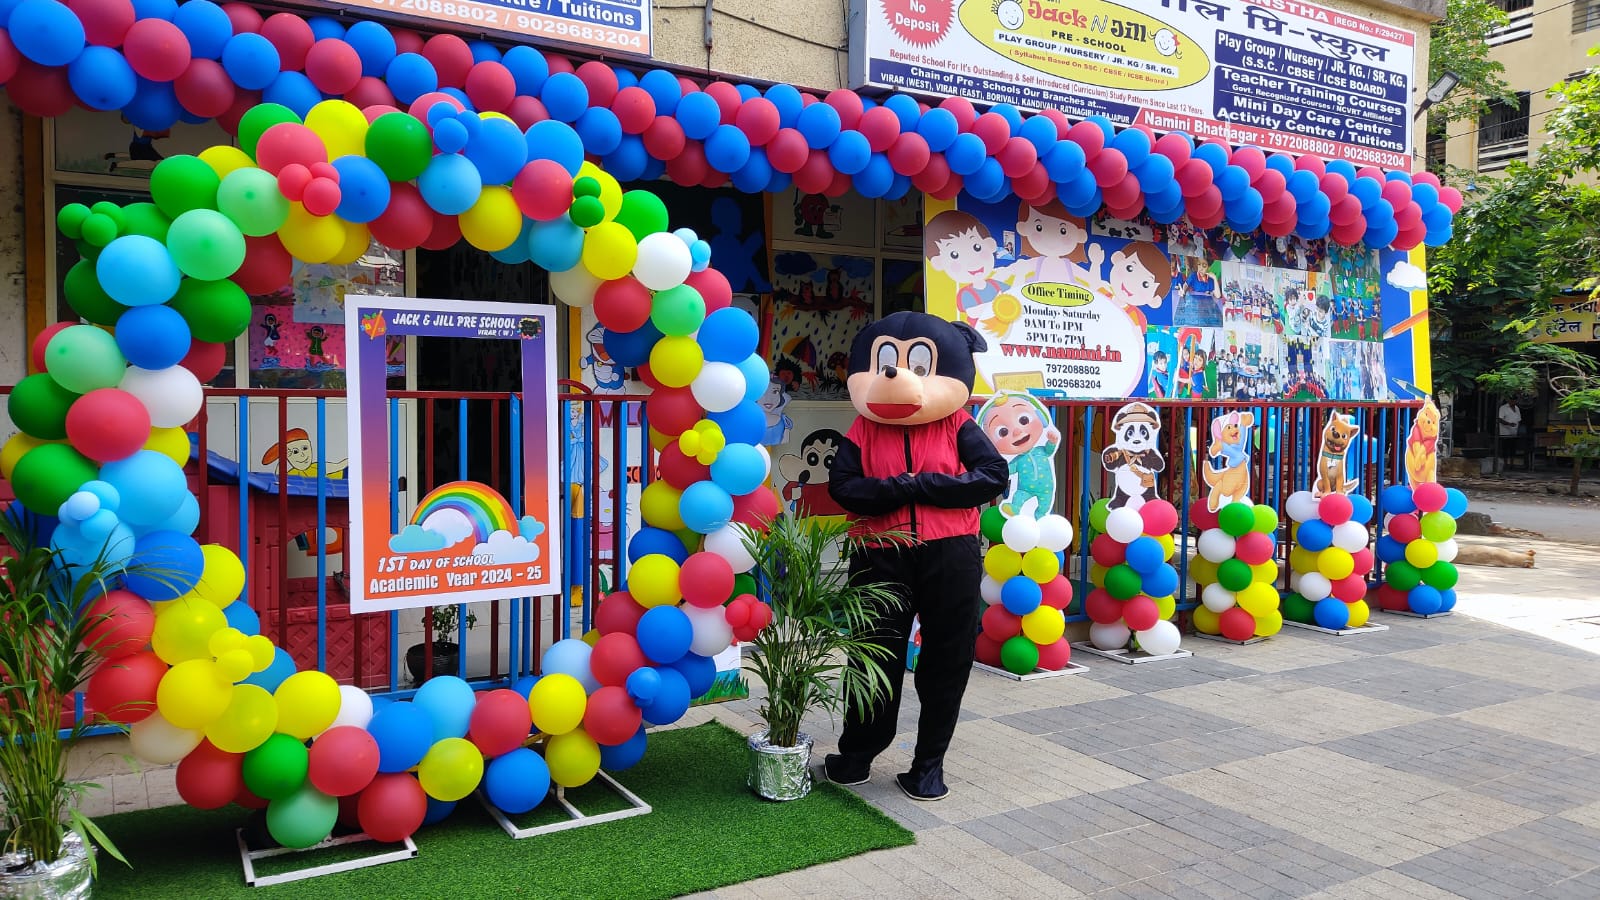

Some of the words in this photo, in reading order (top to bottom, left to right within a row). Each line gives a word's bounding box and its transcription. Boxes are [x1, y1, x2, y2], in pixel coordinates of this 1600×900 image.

[558, 0, 635, 26] Tuitions
[910, 0, 926, 14] No
[1028, 0, 1088, 29] Jack
[1090, 14, 1109, 34] N
[1110, 19, 1147, 42] Jill
[516, 15, 641, 48] 9029683204
[895, 12, 940, 34] Deposit
[998, 33, 1022, 45] PLAY
[1025, 38, 1057, 51] GROUP
[1064, 47, 1106, 62] NURSERY
[1112, 57, 1125, 66] JR.
[1127, 60, 1139, 69] KG
[1145, 63, 1159, 72] SR.
[1161, 66, 1175, 76] KG.
[1051, 30, 1073, 42] PRE
[1083, 37, 1127, 53] SCHOOL
[1015, 50, 1045, 61] Syllabus
[1048, 56, 1070, 67] Based
[1072, 60, 1082, 68] On
[1084, 63, 1098, 72] SSC
[1104, 66, 1122, 77] CBSE
[1128, 72, 1143, 82] ICSE
[1218, 31, 1242, 52] Play
[1244, 38, 1275, 60] Group
[1284, 47, 1323, 72] Nursery
[1331, 60, 1346, 75] JR.
[1348, 63, 1366, 79] KG.
[1372, 69, 1388, 84] SR.
[1390, 74, 1406, 89] KG.
[881, 72, 905, 86] VIRAR
[906, 77, 934, 93] (WEST),
[936, 83, 958, 97] VIRAR
[959, 87, 985, 101] (EAST),
[986, 92, 1019, 107] BORIVALI,
[889, 49, 920, 64] Reputed
[921, 55, 946, 69] School
[947, 60, 959, 71] For
[960, 63, 971, 74] It's
[973, 64, 1013, 81] Outstanding
[1014, 72, 1020, 81] &
[1022, 73, 1035, 84] Self
[1036, 76, 1070, 91] Introduced
[1110, 90, 1127, 104] Study
[1127, 94, 1151, 107] Pattern
[1150, 98, 1165, 108] Since
[1166, 101, 1179, 111] Last
[1180, 103, 1188, 112] 12
[1188, 104, 1204, 116] Years.
[910, 67, 940, 81] Chain
[943, 73, 954, 84] of
[956, 76, 974, 88] Pre
[983, 79, 1020, 95] Schools
[1023, 87, 1041, 98] Our
[1042, 90, 1083, 106] Branches
[1221, 67, 1284, 91] Teacher
[1288, 81, 1345, 106] Training
[1349, 94, 1402, 116] Courses
[1242, 55, 1278, 72] (S.S.C.
[1287, 65, 1315, 81] CBSE
[1323, 73, 1347, 88] ICSE
[1349, 78, 1387, 99] BOARD)
[1232, 83, 1253, 95] Govt.
[1256, 87, 1299, 105] Recognized
[1301, 97, 1331, 111] Courses
[1362, 109, 1393, 122] Affiliated
[1233, 95, 1267, 112] Mini
[1272, 102, 1302, 121] Day
[1306, 109, 1341, 127] Care
[1345, 118, 1392, 137] Centre
[1144, 109, 1191, 132] Namini
[1194, 119, 1258, 143] Bhatnagar
[1267, 131, 1336, 156] 7972088802
[1343, 146, 1405, 168] 9029683204
[1217, 107, 1281, 131] Activity
[1285, 119, 1337, 139] Centre
[1347, 130, 1404, 152] Tuitions
[1027, 285, 1055, 298] Office
[1056, 287, 1090, 302] Timing
[392, 313, 420, 326] JACK
[422, 314, 431, 326] &
[433, 314, 455, 327] JILL
[456, 316, 477, 329] PRE
[478, 317, 516, 330] SCHOOL
[1024, 318, 1046, 330] 9AM
[1048, 319, 1061, 330] To
[1062, 308, 1101, 322] Saturday
[477, 329, 497, 337] VIRAR
[503, 329, 509, 337] W
[1026, 332, 1048, 343] 5PM
[1050, 333, 1063, 344] To
[1065, 334, 1085, 345] 7PM
[1000, 342, 1122, 362] www.namini.in
[1046, 363, 1101, 376] 7972088802
[1046, 378, 1101, 391] 9029683204
[377, 556, 408, 573] 1ST
[409, 559, 433, 572] DAY
[435, 557, 451, 569] OF
[452, 554, 496, 569] SCHOOL
[369, 574, 439, 594] Academic
[446, 571, 479, 587] Year
[481, 567, 513, 586] 2024
[526, 565, 543, 581] 25
